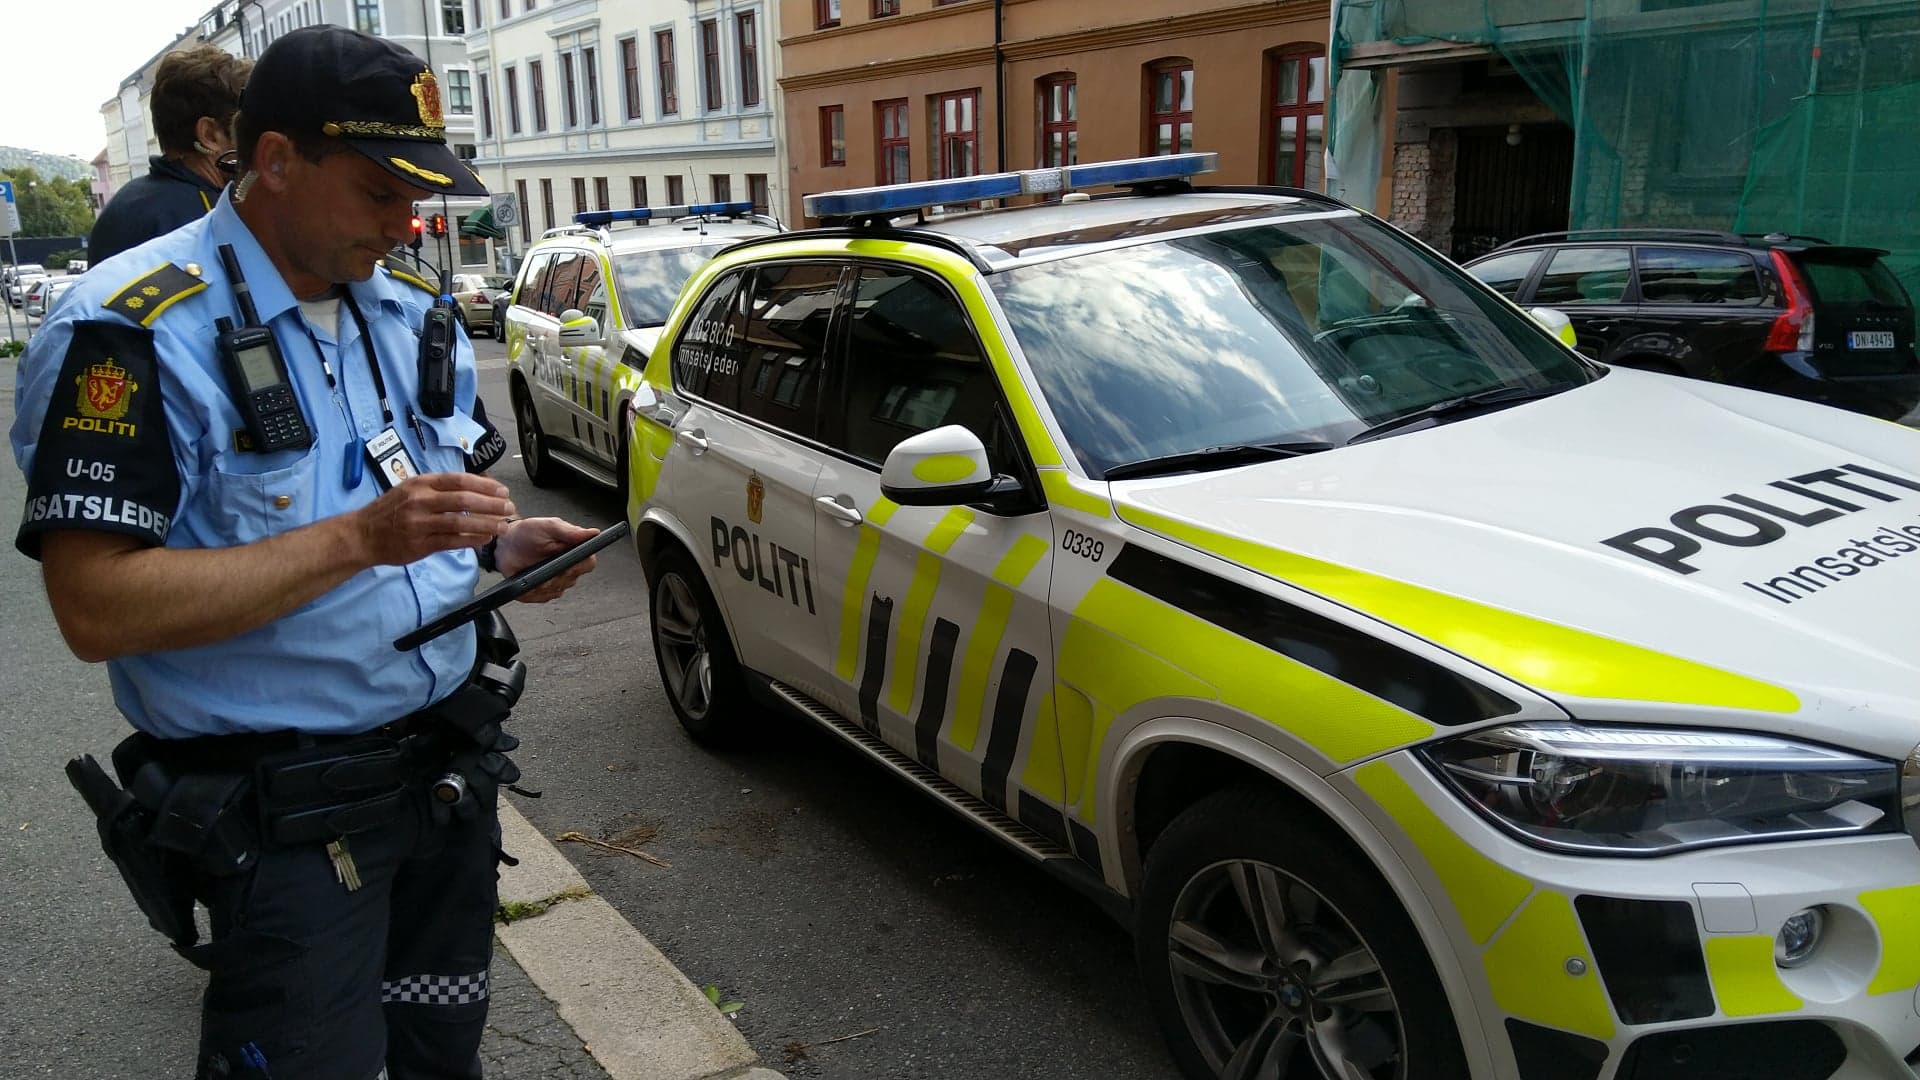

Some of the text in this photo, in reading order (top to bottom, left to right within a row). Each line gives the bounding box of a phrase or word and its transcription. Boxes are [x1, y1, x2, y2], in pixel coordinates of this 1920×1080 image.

[499, 208, 512, 219] 30
[1855, 333, 1866, 347] DN
[1870, 333, 1893, 347] 49475
[63, 416, 136, 437] POLITI
[470, 430, 504, 467] INNS
[66, 458, 116, 482] U-05
[1599, 463, 1920, 576] POLITI
[1062, 529, 1105, 562] 0339
[711, 515, 816, 616] POLITI
